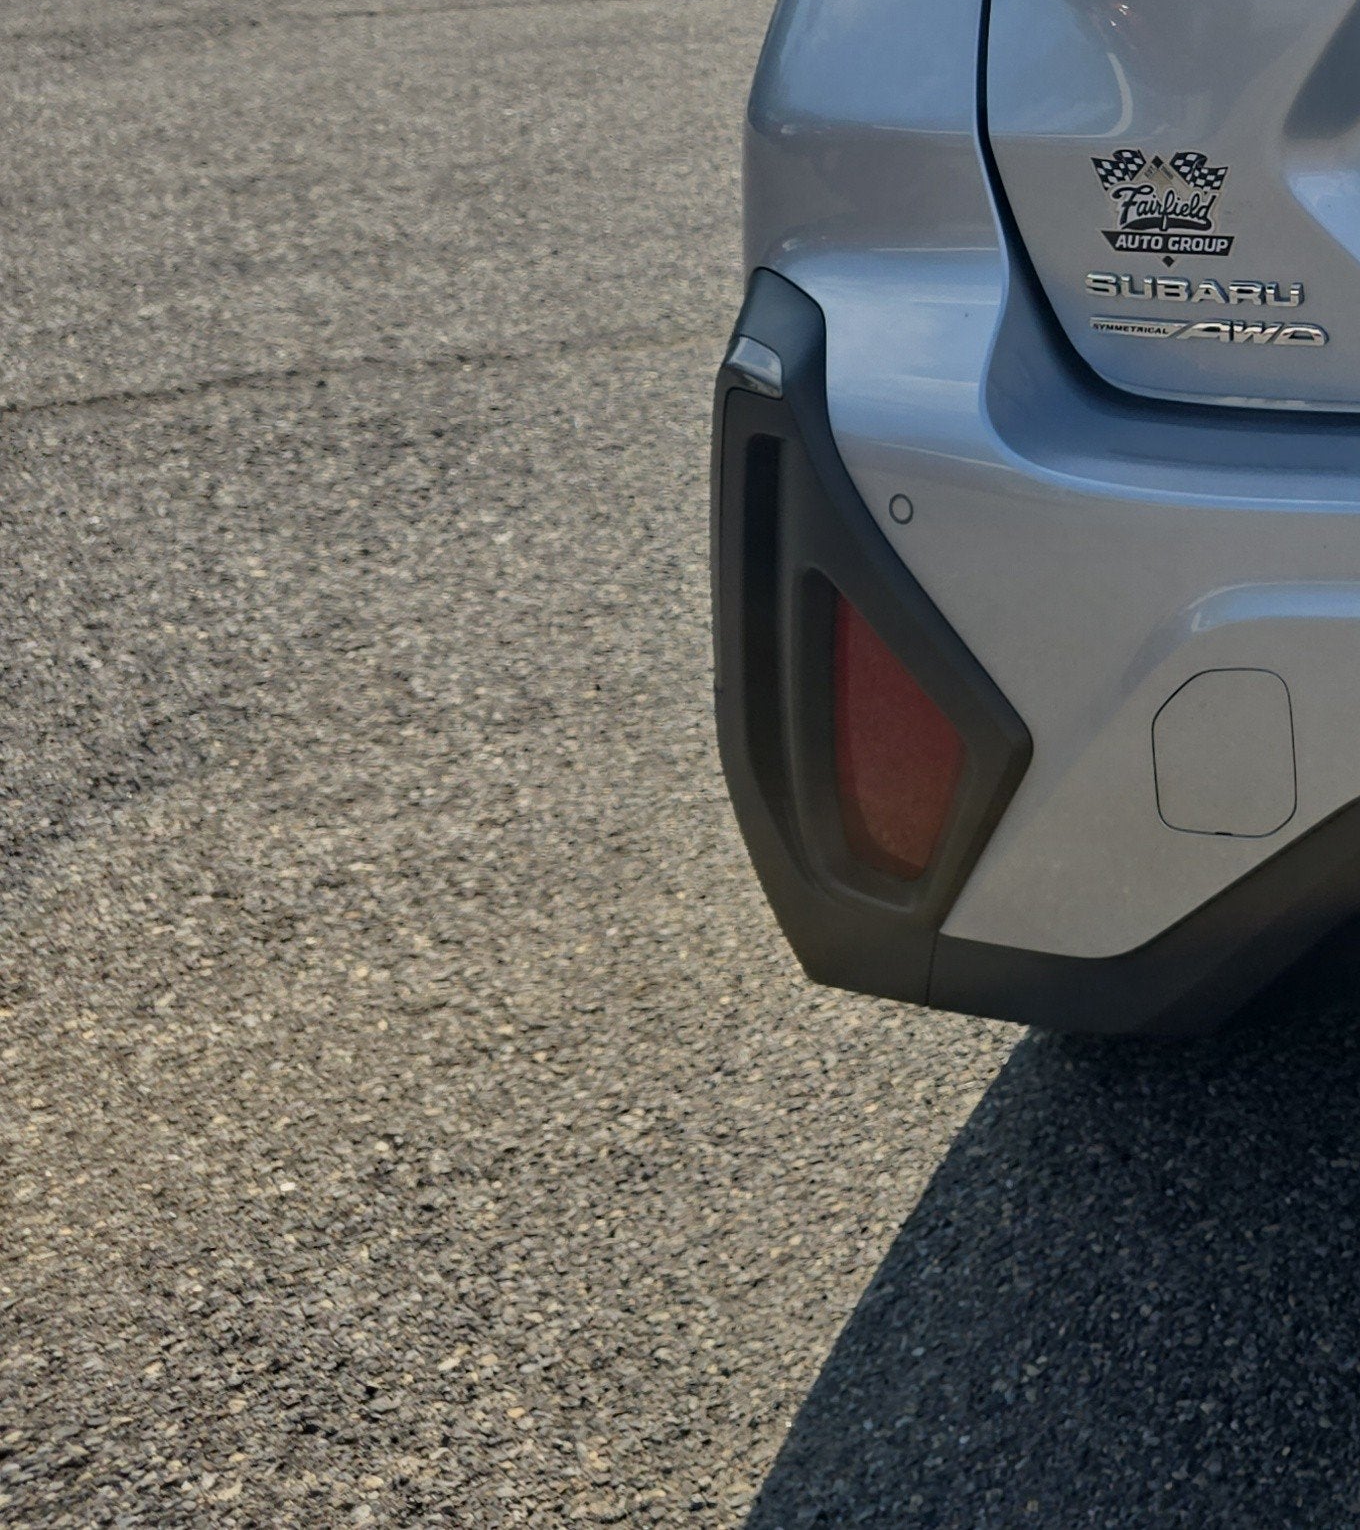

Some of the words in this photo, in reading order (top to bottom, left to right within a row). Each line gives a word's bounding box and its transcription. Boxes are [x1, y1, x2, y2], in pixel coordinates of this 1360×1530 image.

[1111, 184, 1216, 227] Fairfield
[1115, 233, 1163, 250] AUTO
[1167, 234, 1229, 253] GROUP
[1085, 271, 1304, 307] SUBARU
[1092, 322, 1169, 335] SYMMETRICAL
[1177, 320, 1329, 346] AWD
